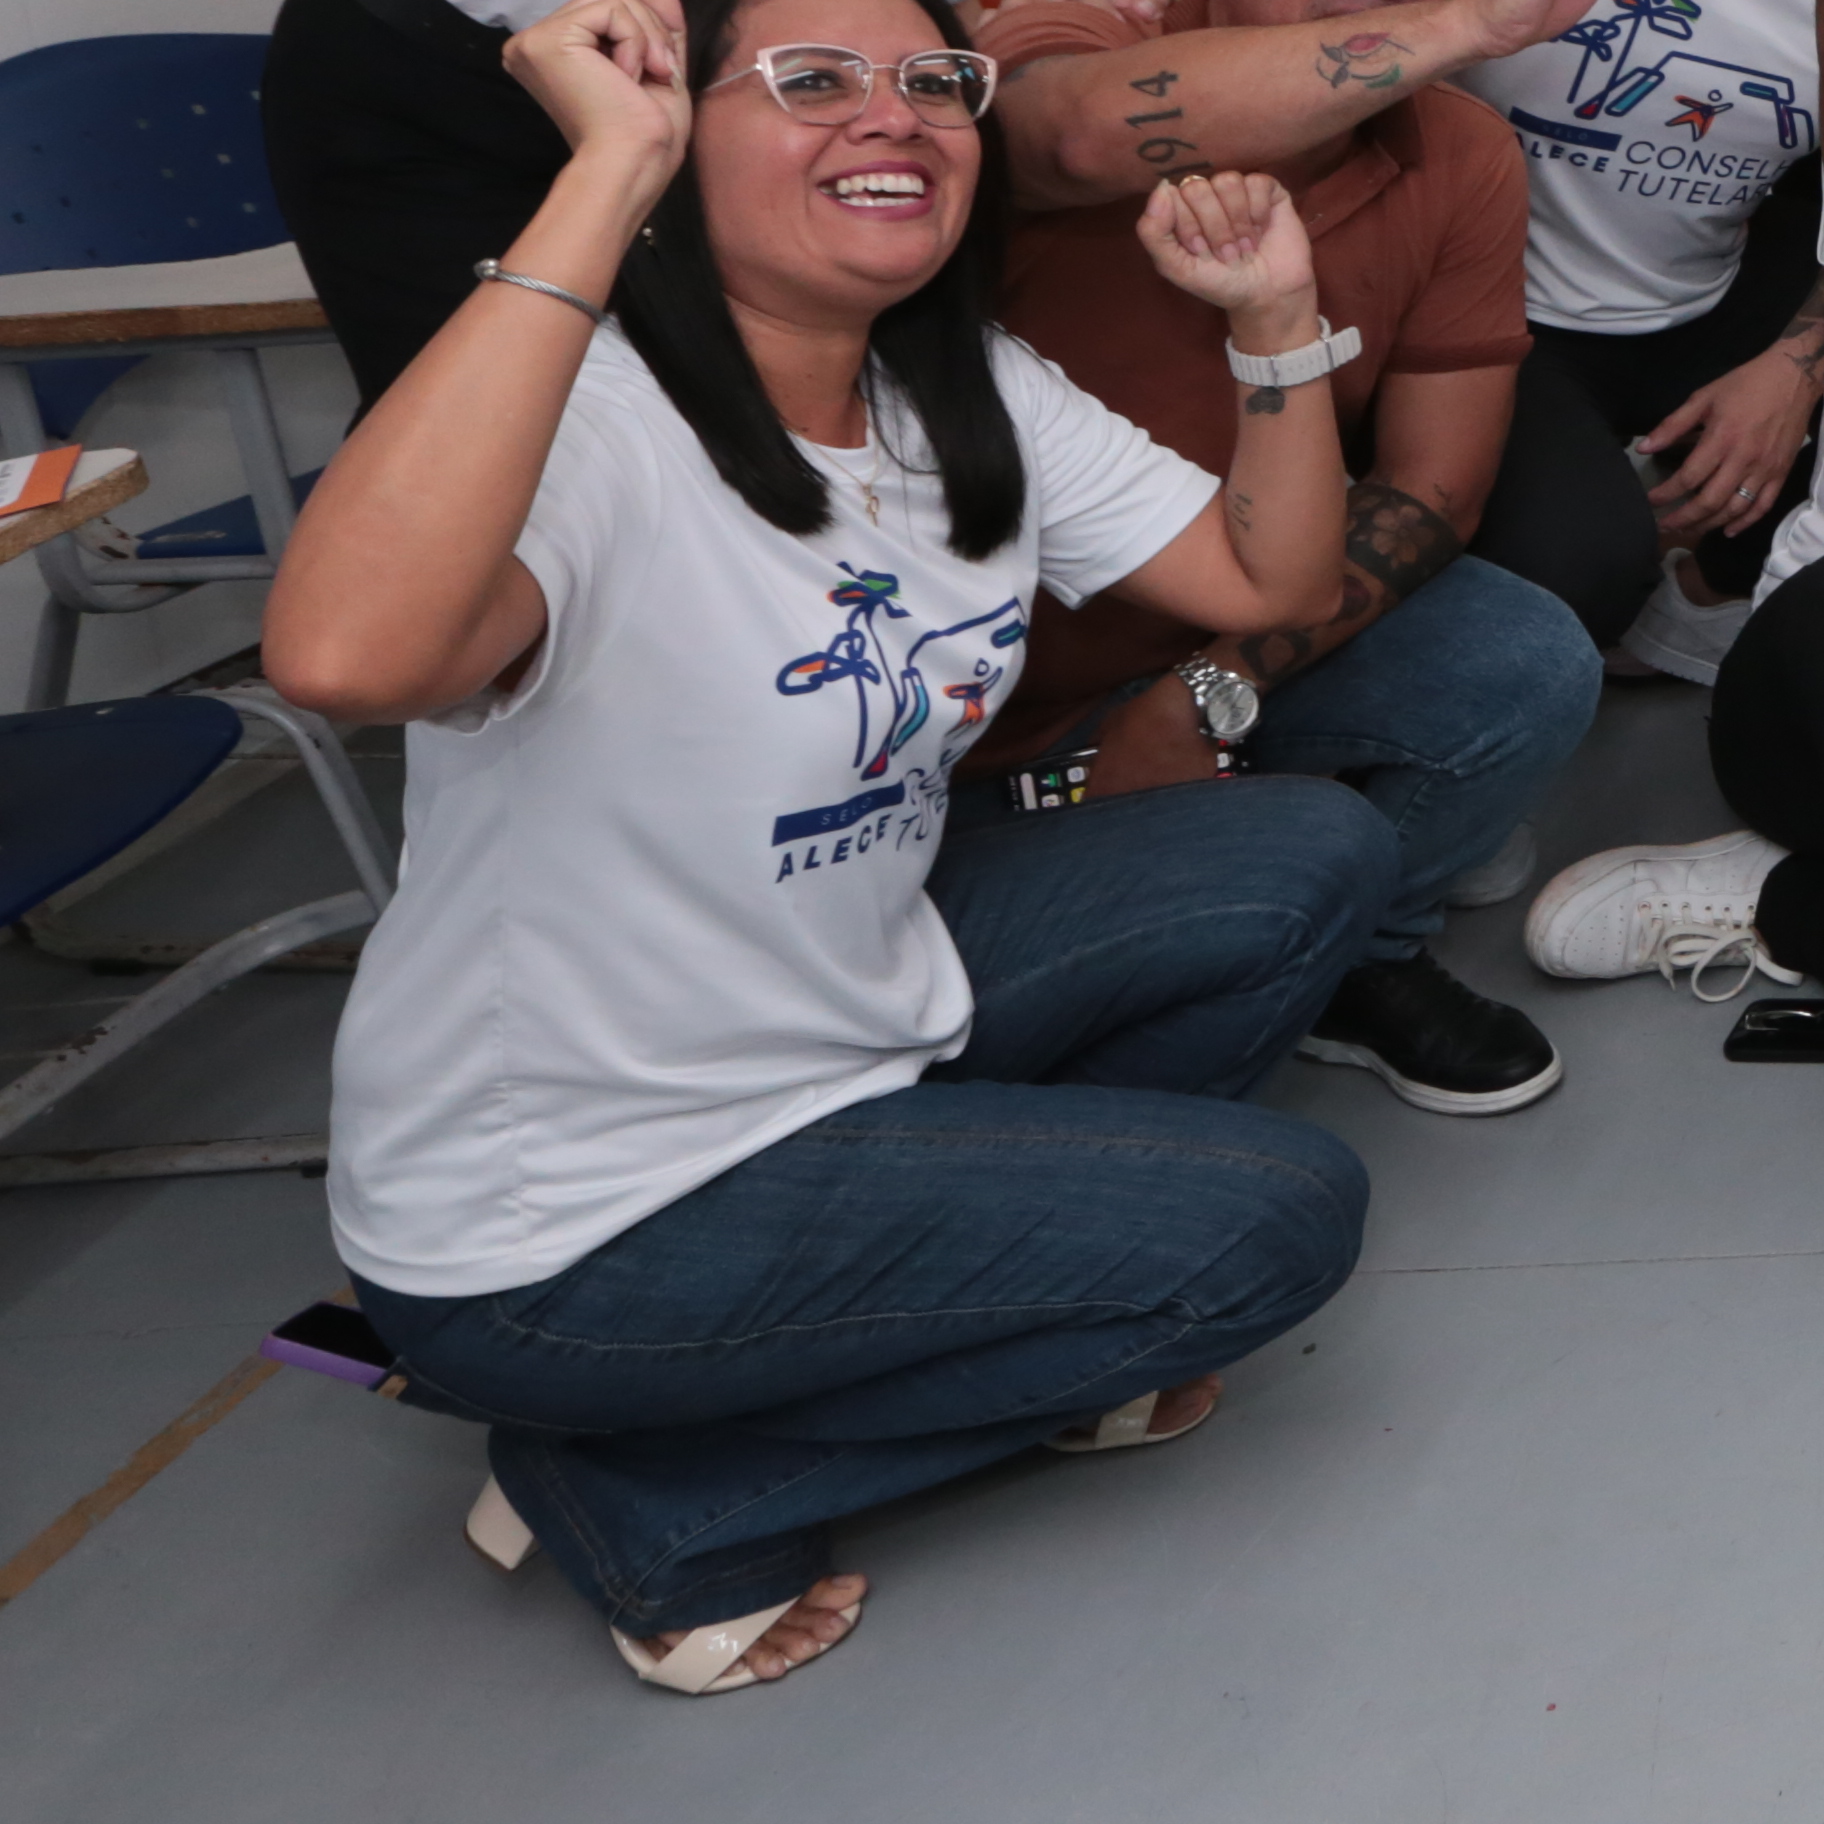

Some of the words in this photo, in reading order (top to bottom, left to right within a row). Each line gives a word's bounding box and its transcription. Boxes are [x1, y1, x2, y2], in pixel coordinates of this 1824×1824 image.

[1516, 133, 1610, 173] LECE
[1626, 140, 1791, 181] CONSELH
[819, 796, 874, 827] SELO
[775, 813, 893, 884] ALECE
